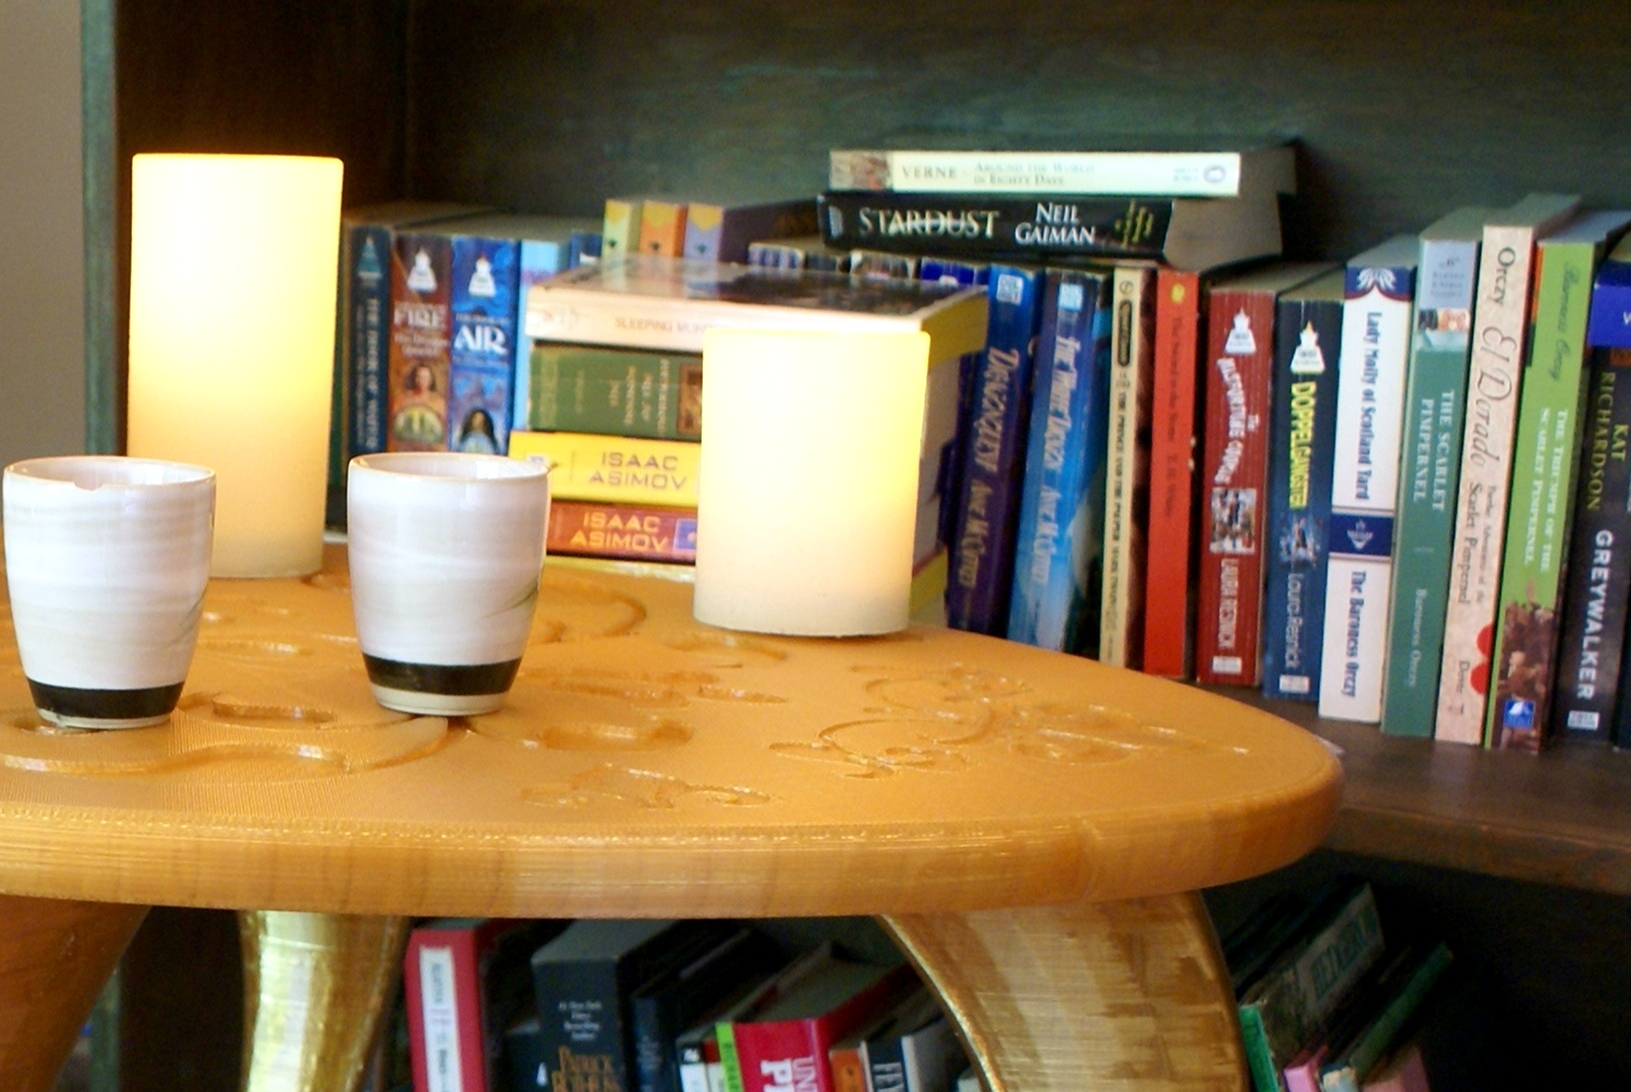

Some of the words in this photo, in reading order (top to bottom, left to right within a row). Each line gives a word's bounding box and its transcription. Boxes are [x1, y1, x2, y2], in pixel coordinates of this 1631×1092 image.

[901, 165, 958, 180] VERNE
[858, 207, 1000, 240] STARDUST
[1035, 202, 1079, 224] NEIL
[1015, 222, 1096, 247] GAIMAN
[1494, 245, 1517, 308] Orczy
[393, 301, 448, 328] FIRE
[1365, 311, 1383, 344] Lady
[454, 325, 509, 355] AIR
[1480, 325, 1518, 366] El
[1362, 389, 1378, 404] of
[1439, 390, 1454, 425] THE
[1288, 381, 1318, 511] DOPPELGANGSTER
[1357, 407, 1378, 465] Scotland
[1413, 398, 1435, 504] PIMPERNEL
[1587, 370, 1617, 511] RICHARDSON
[1610, 422, 1630, 462] KAT
[602, 451, 679, 471] ISAAC
[1431, 433, 1452, 513] SCARLET
[588, 470, 688, 491] ASIMOV
[1354, 470, 1373, 502] Yard
[583, 511, 662, 532] ISAAC
[1466, 481, 1484, 529] Scarlet
[569, 530, 669, 553] ASIMOV
[1351, 570, 1368, 595] The
[1452, 535, 1478, 606] Pimpernel
[1347, 598, 1367, 657] Baroness
[1577, 529, 1615, 700] GREYWALKER
[1340, 661, 1359, 698] Orczy
